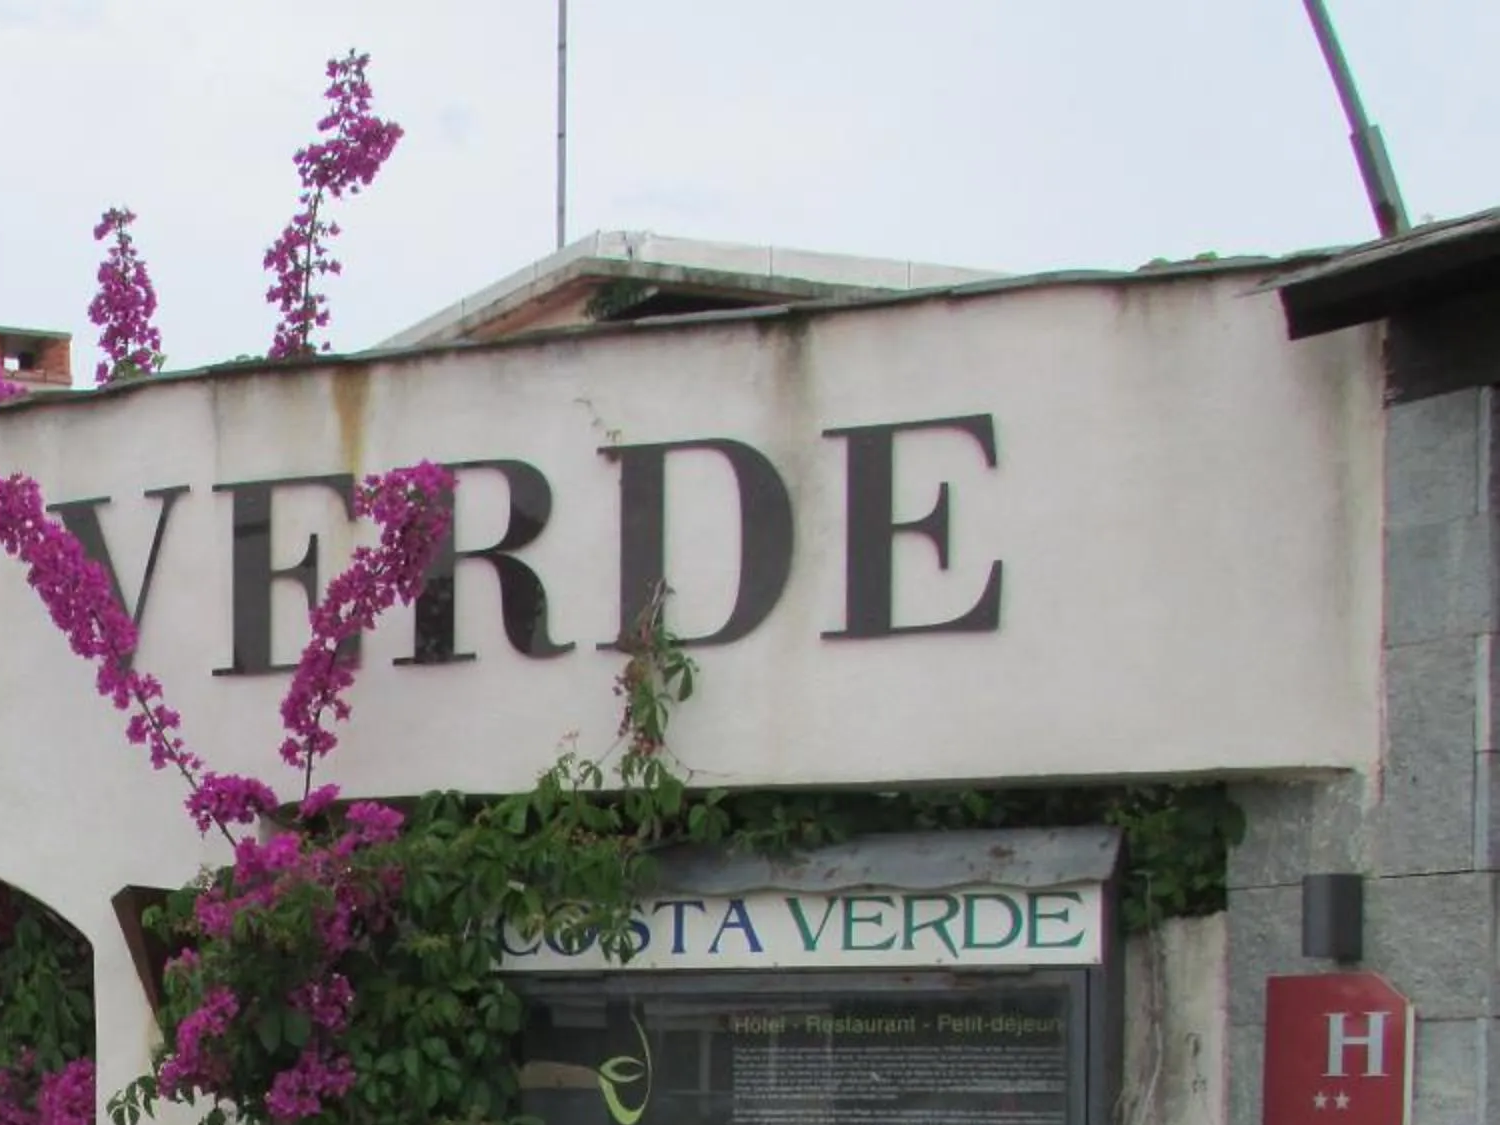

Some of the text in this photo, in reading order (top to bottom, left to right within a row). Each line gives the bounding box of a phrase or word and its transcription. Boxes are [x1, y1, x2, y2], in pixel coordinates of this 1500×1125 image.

[46, 412, 1003, 678] VERDE
[786, 891, 1086, 959] VERDE
[805, 1013, 917, 1035] Restaurant
[1321, 1011, 1391, 1077] H
